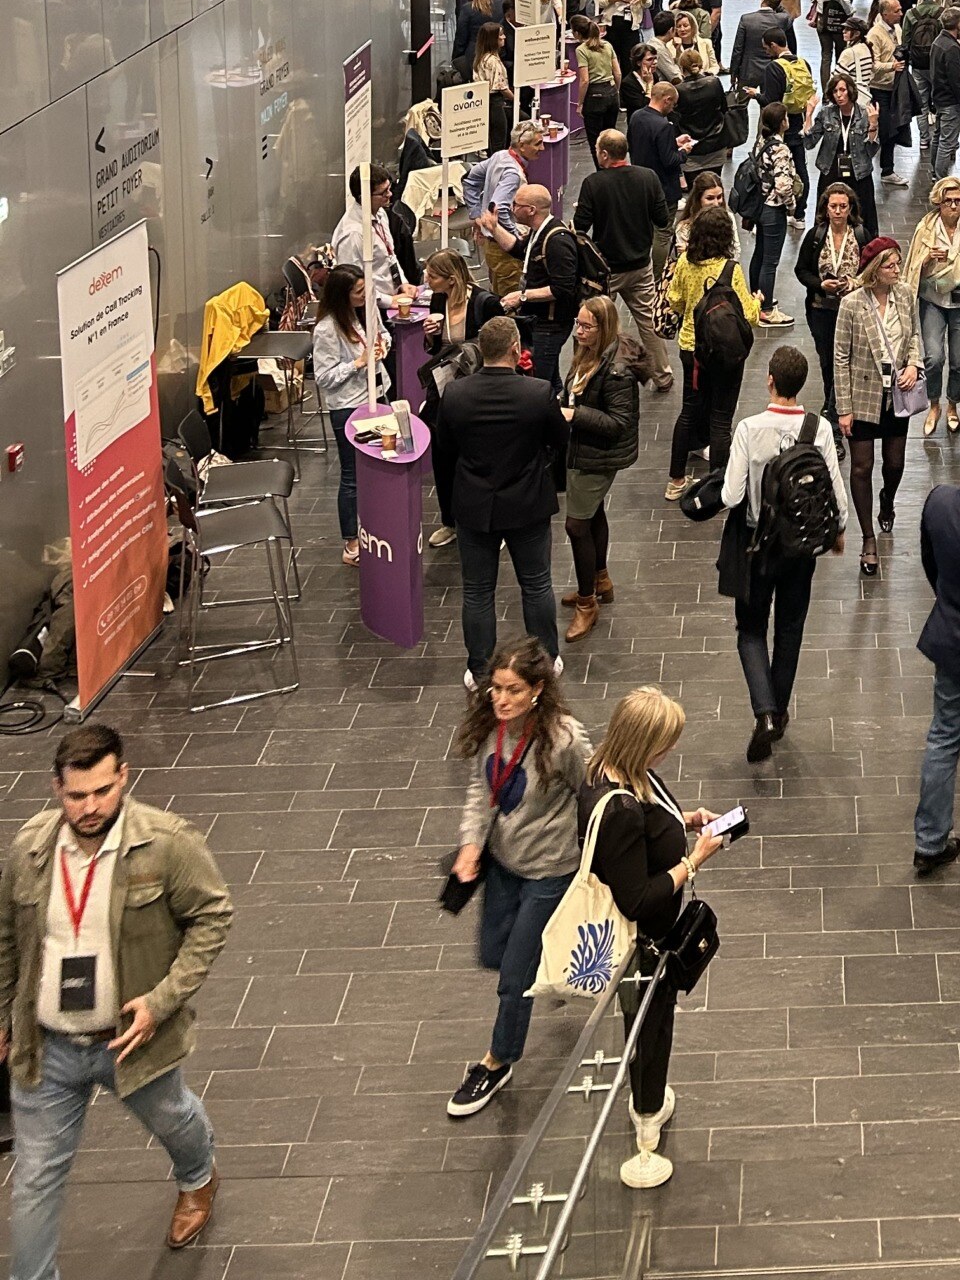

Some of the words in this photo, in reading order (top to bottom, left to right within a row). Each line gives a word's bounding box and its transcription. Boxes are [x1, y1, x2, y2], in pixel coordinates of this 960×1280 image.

[260, 72, 274, 96] GRAND
[276, 61, 290, 82] FOYER
[274, 91, 288, 113] FOYER
[453, 99, 483, 112] avanci
[96, 159, 118, 189] GRAND
[121, 127, 160, 170] AUDITORIUM
[97, 187, 118, 218] PETIT
[122, 168, 143, 198] FOYER
[98, 210, 126, 240] VESTIAIRES
[88, 266, 122, 296] dexem
[70, 318, 95, 340] Solution
[96, 312, 104, 322] de
[104, 300, 118, 315] Call
[118, 285, 142, 306] Tracking
[87, 330, 98, 345] N°1
[100, 326, 107, 336] en
[108, 311, 129, 330] France
